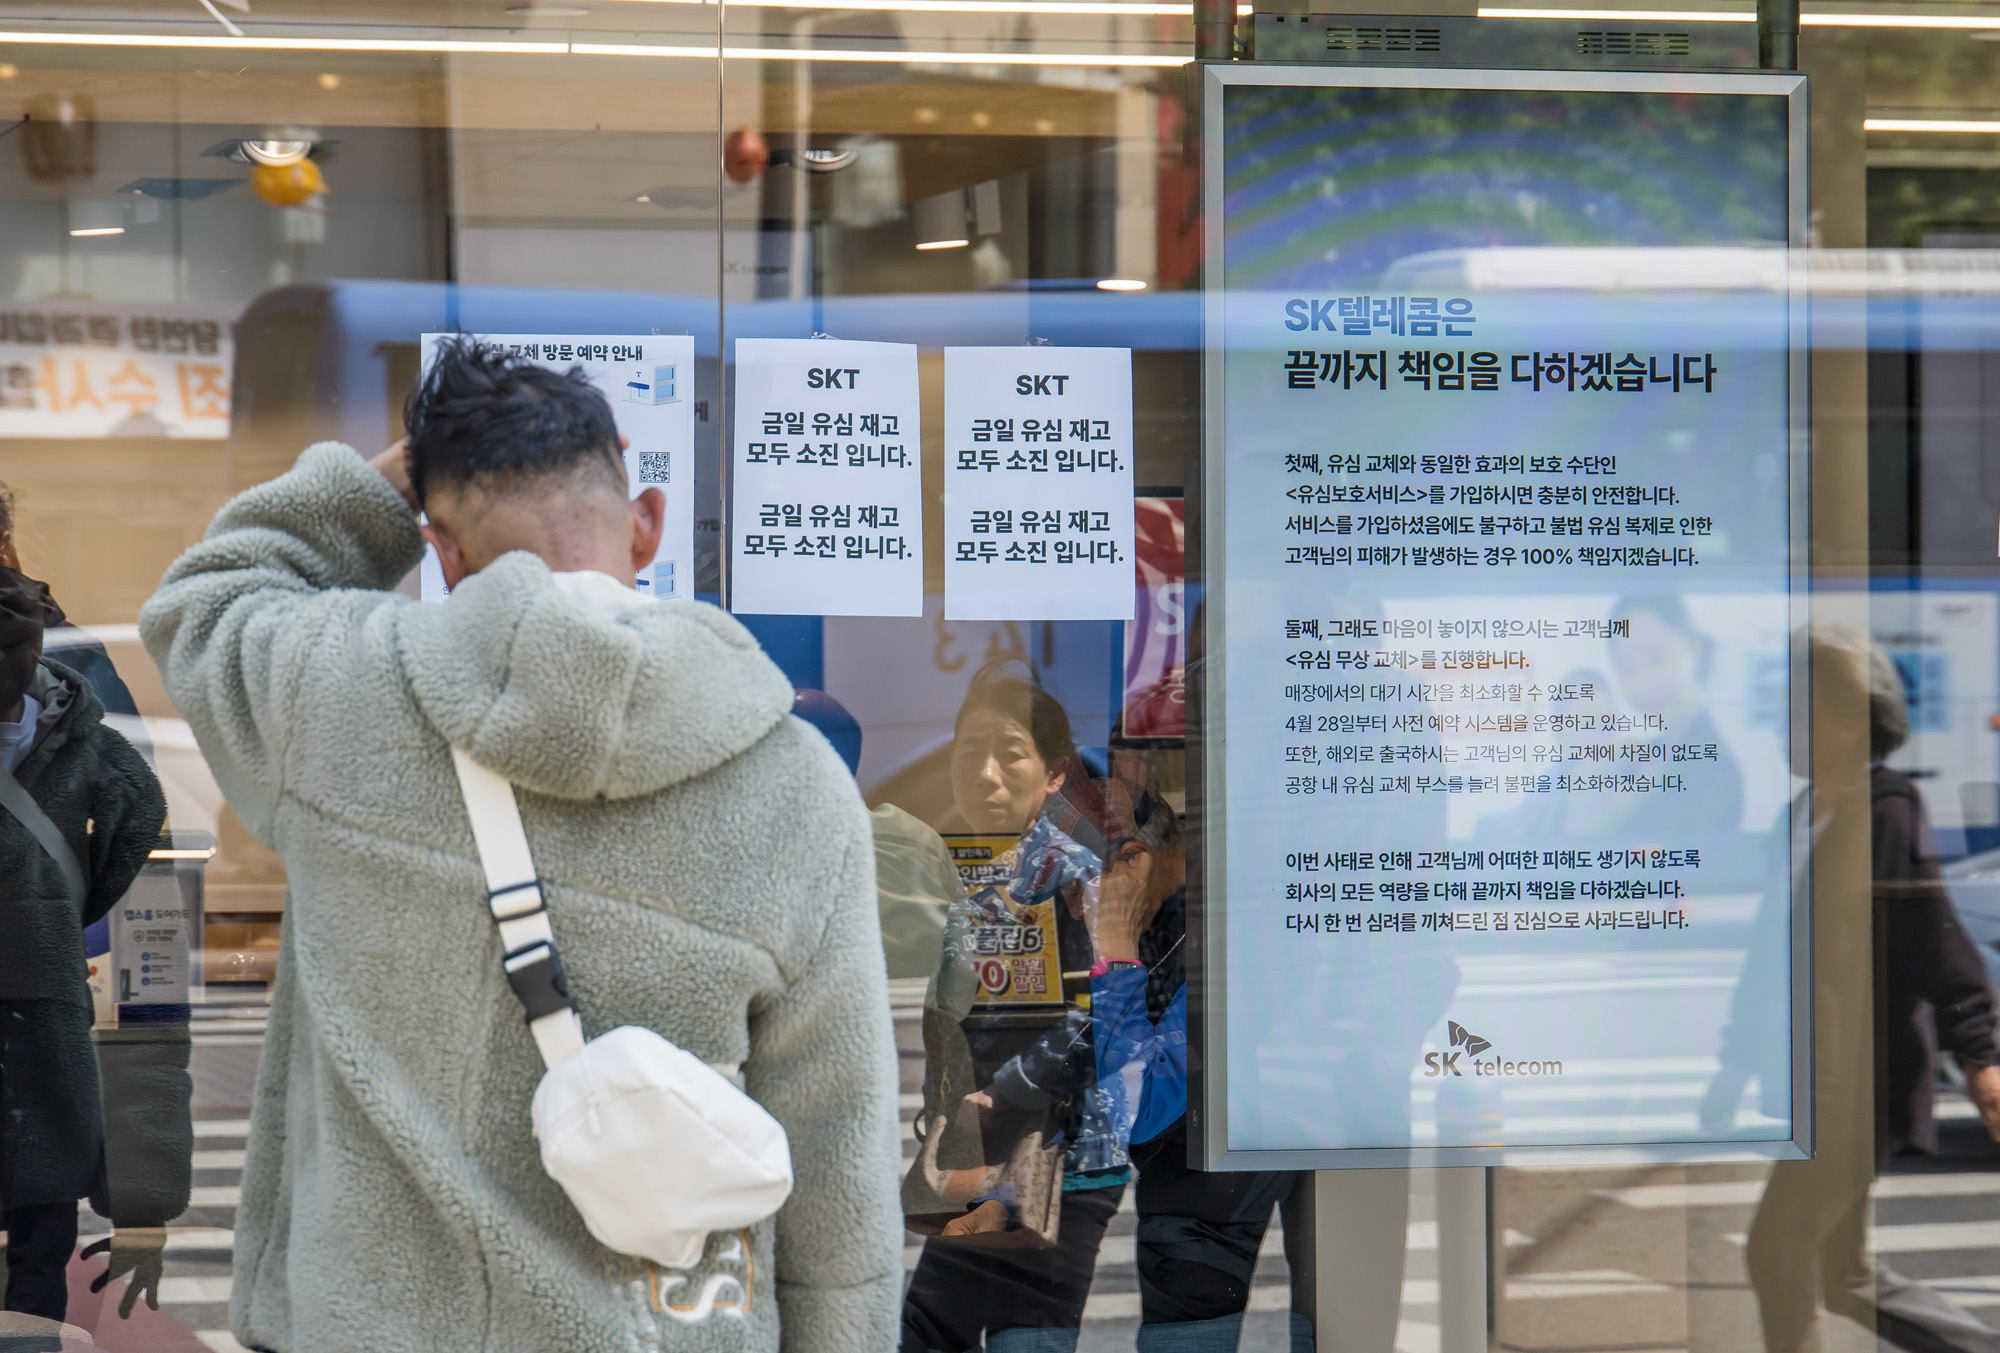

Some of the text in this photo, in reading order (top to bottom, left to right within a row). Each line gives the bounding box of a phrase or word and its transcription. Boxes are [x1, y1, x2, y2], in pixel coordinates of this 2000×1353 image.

[1285, 296, 1476, 336] SK텔레콤은
[509, 344, 539, 361] 교체
[543, 344, 574, 361] 방문
[577, 345, 608, 361] 예약
[612, 345, 642, 361] 안내
[807, 368, 860, 389] SKT
[1284, 350, 1717, 393] 끝까지 책임을 다하겠습니다
[1016, 375, 1069, 395] SKT
[762, 412, 899, 437] 금일 유심 재고
[972, 419, 1111, 442] 금일 유심 재고
[746, 443, 912, 468] 모두 소진 입니다.
[957, 449, 1124, 472] 모두 소진 입니다.
[1285, 454, 1616, 476] 첫째, 유심 교체와 동일한 효과의 보호 수단인
[1286, 484, 1679, 505] <유심보호서비스>를 가입하시면 충분히 안전합니다.
[759, 504, 899, 529] 금일 유심 재고
[970, 510, 1110, 533] 금일 유심 재고
[1285, 515, 1712, 536] 서비스를 가입하셨음에도 불구하고 불법 유심 복제로 인한
[744, 535, 912, 560] 모두 소진 입니다.
[956, 540, 1123, 564] 모두 소진 입니다.
[1285, 546, 1699, 566] 고객님의 피해가 발생하는 경우 100% 책임지겠습니다.
[1285, 619, 1629, 640] 둘째, 그래도 마음이 놓이지 않으시는 고객님께
[1336, 650, 1370, 669] 무상
[1442, 650, 1529, 669] 진행합니다.
[1286, 684, 1595, 702] 매장에서의 대기 시간을 최소화할 수 있도록
[1285, 714, 1667, 733] 4월 28일부터 사전 예약 시스템을 운영하고 있습니다.
[1285, 744, 1718, 765] 또한, 해외로 출국하시는 고객님의 유심 교체에 차질이 없도록
[1285, 774, 1686, 794] 공항 내 유심 교체 부스를 늘려 불편을 최소화하겠습니다.
[1286, 849, 1701, 872] 이번 사태로 인해 고객님께 어떠한 피해도 생기지 않도록
[1286, 880, 1684, 902] 회사의 모든 역량을 다해 끝까지 책임을 다하겠습니다.
[1287, 910, 1689, 933] 다시 한 번 심려를 끼쳐드린 점 진심으로 사과드립니다.
[1013, 975, 1045, 990] 할인
[1424, 1052, 1562, 1077] SK telecom
